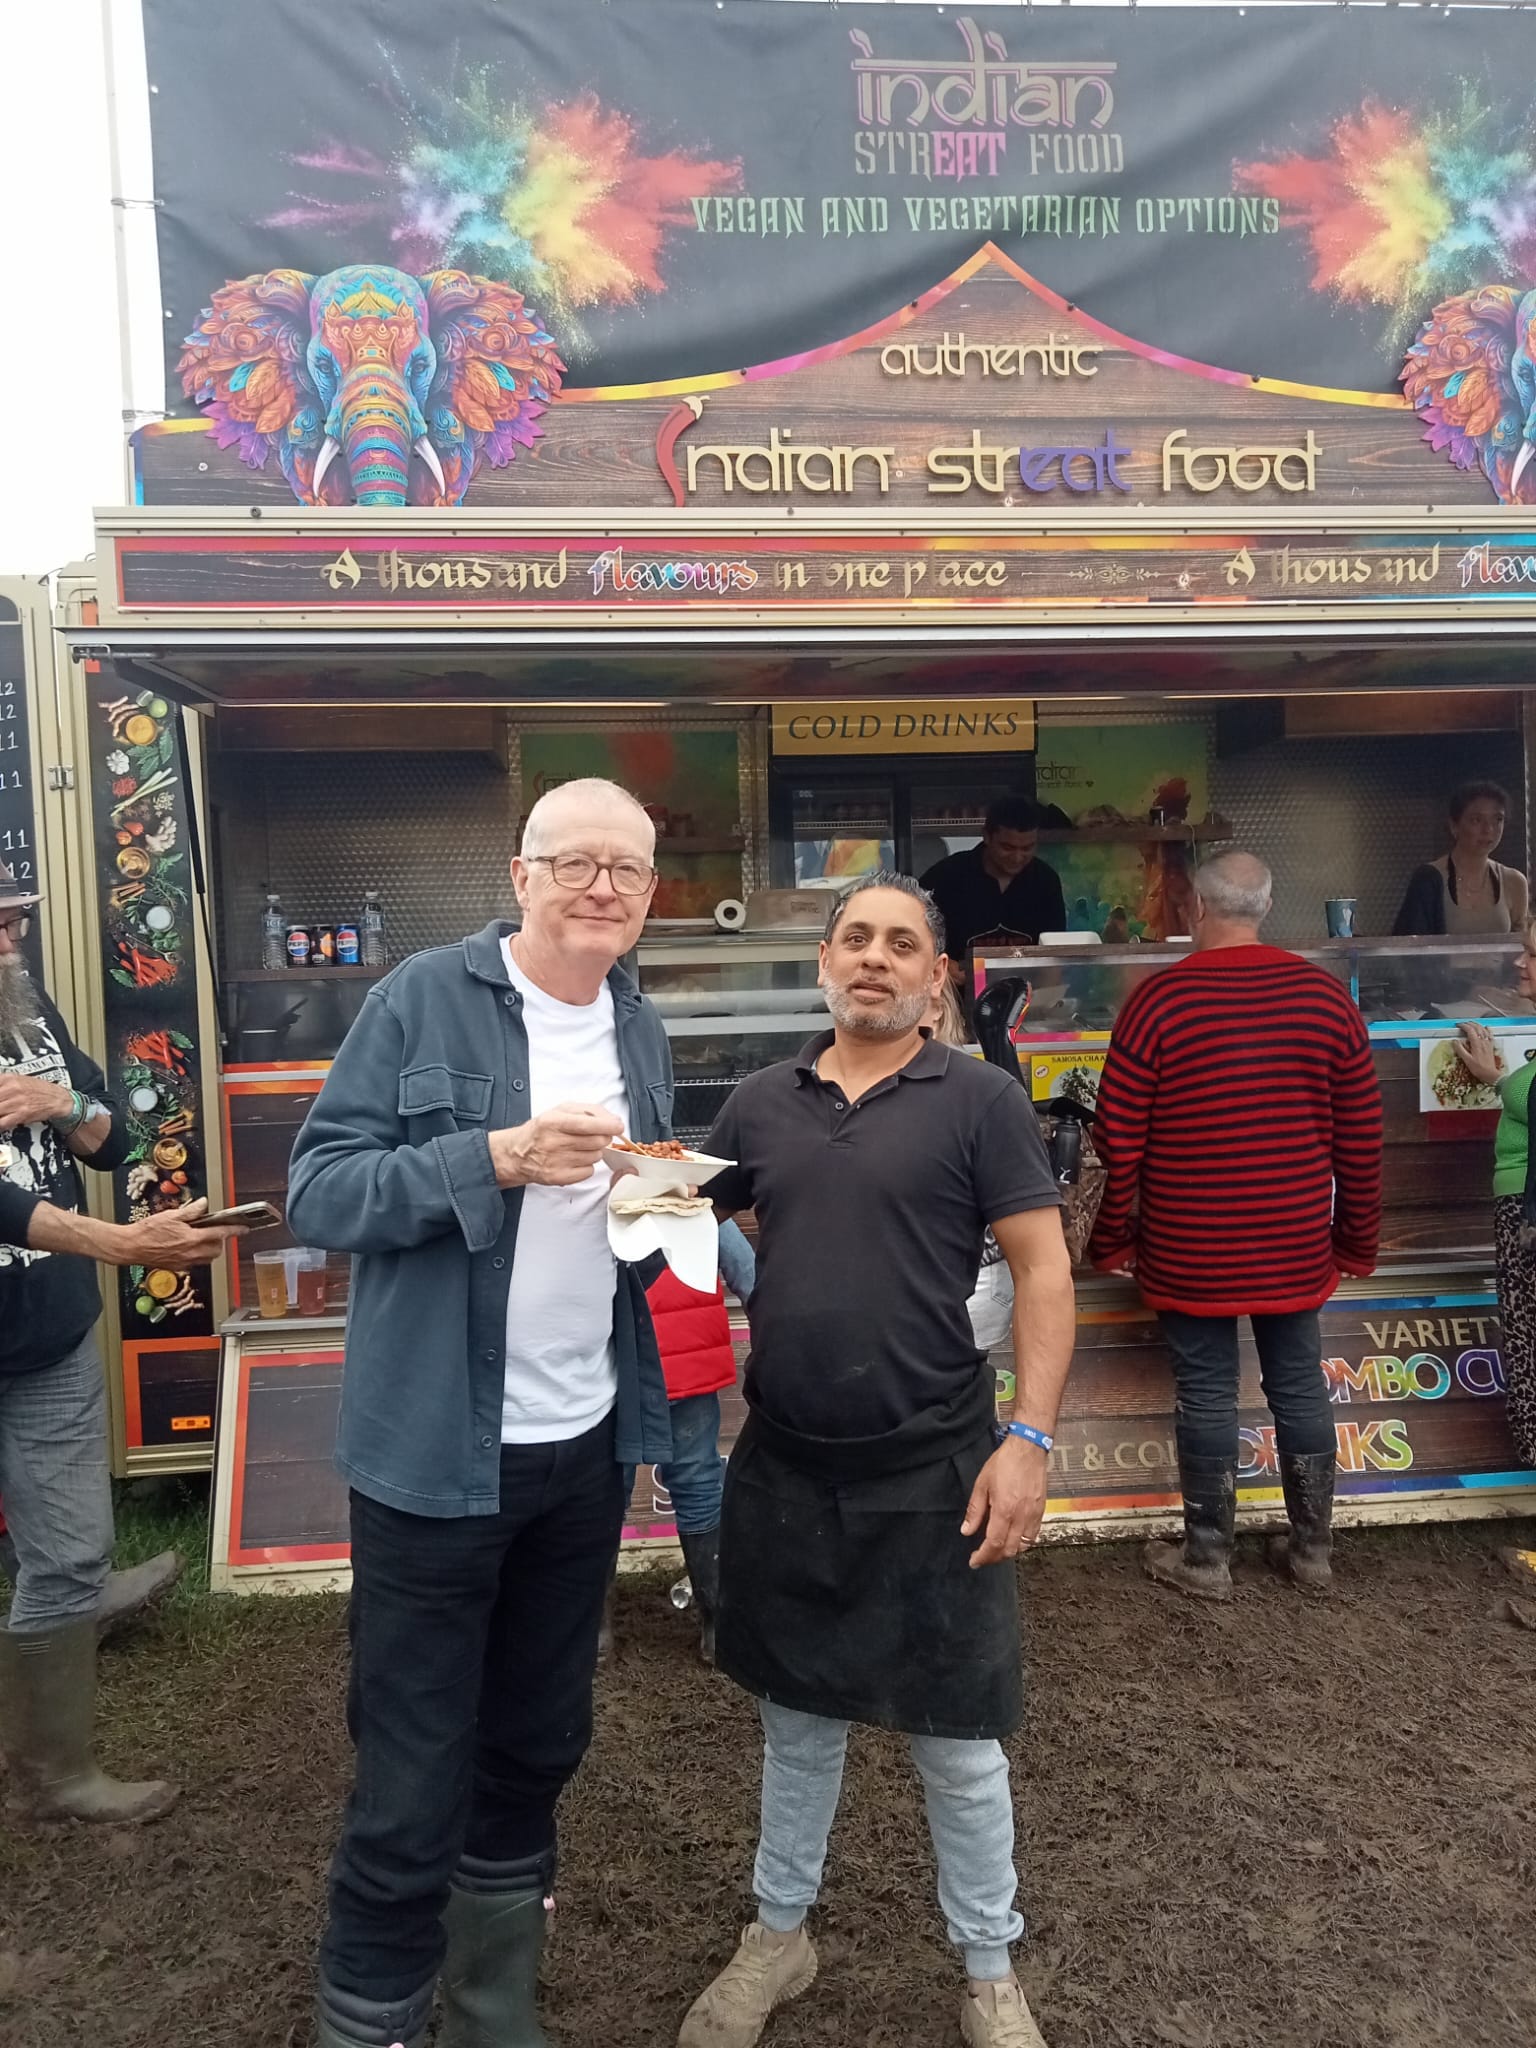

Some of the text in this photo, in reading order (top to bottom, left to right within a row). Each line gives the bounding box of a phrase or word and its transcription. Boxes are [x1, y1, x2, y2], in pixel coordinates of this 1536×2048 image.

[849, 16, 1118, 128] indian
[854, 130, 1125, 182] STREAT FOOD
[691, 197, 1280, 238] VEGAN AND VEGETARIAN OPTIONS
[880, 332, 1103, 378] authentic
[928, 429, 1132, 493] streat
[1162, 429, 1323, 493] food
[320, 547, 361, 589] A
[588, 546, 758, 595] flavours
[823, 561, 892, 592] one
[1221, 545, 1256, 586] A
[1457, 541, 1536, 588] flav
[788, 711, 1019, 740] COLD DRINKS
[2, 829, 30, 851] 11
[7, 861, 33, 881] 12
[1114, 1440, 1179, 1470] COL
